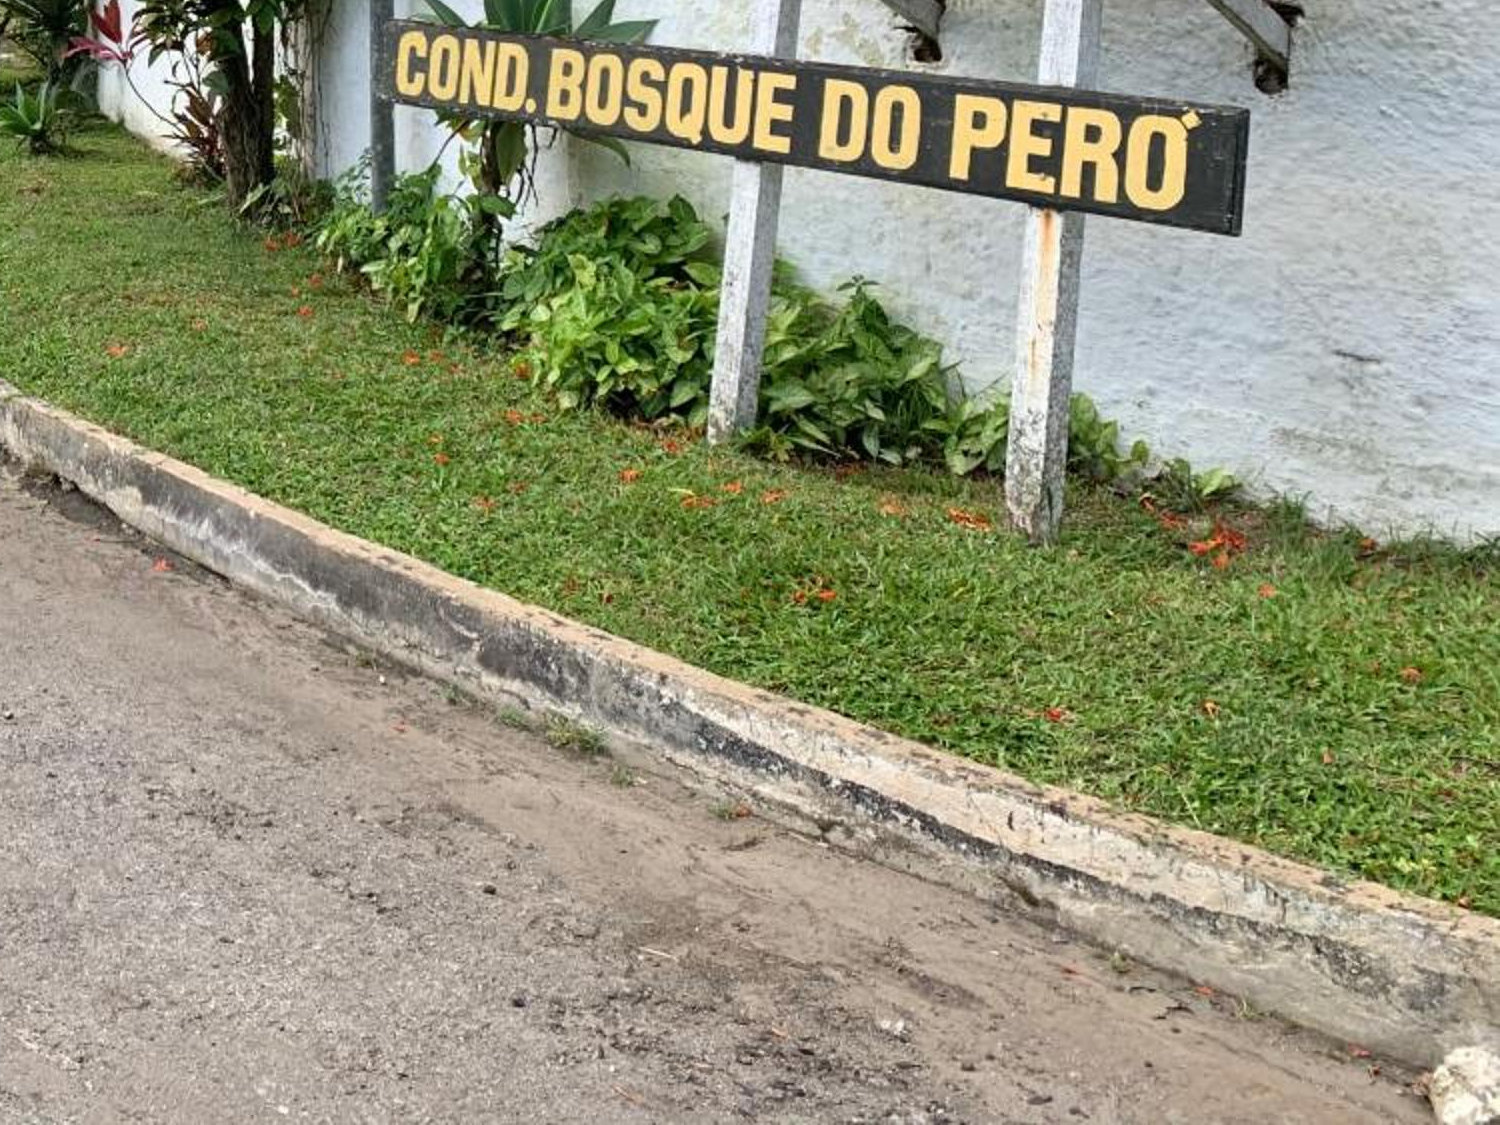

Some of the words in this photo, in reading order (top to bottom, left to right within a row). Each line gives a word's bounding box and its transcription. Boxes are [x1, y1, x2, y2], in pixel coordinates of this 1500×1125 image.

[395, 30, 537, 114] COND.
[545, 48, 795, 154] BOSQUE
[818, 78, 921, 170] DO
